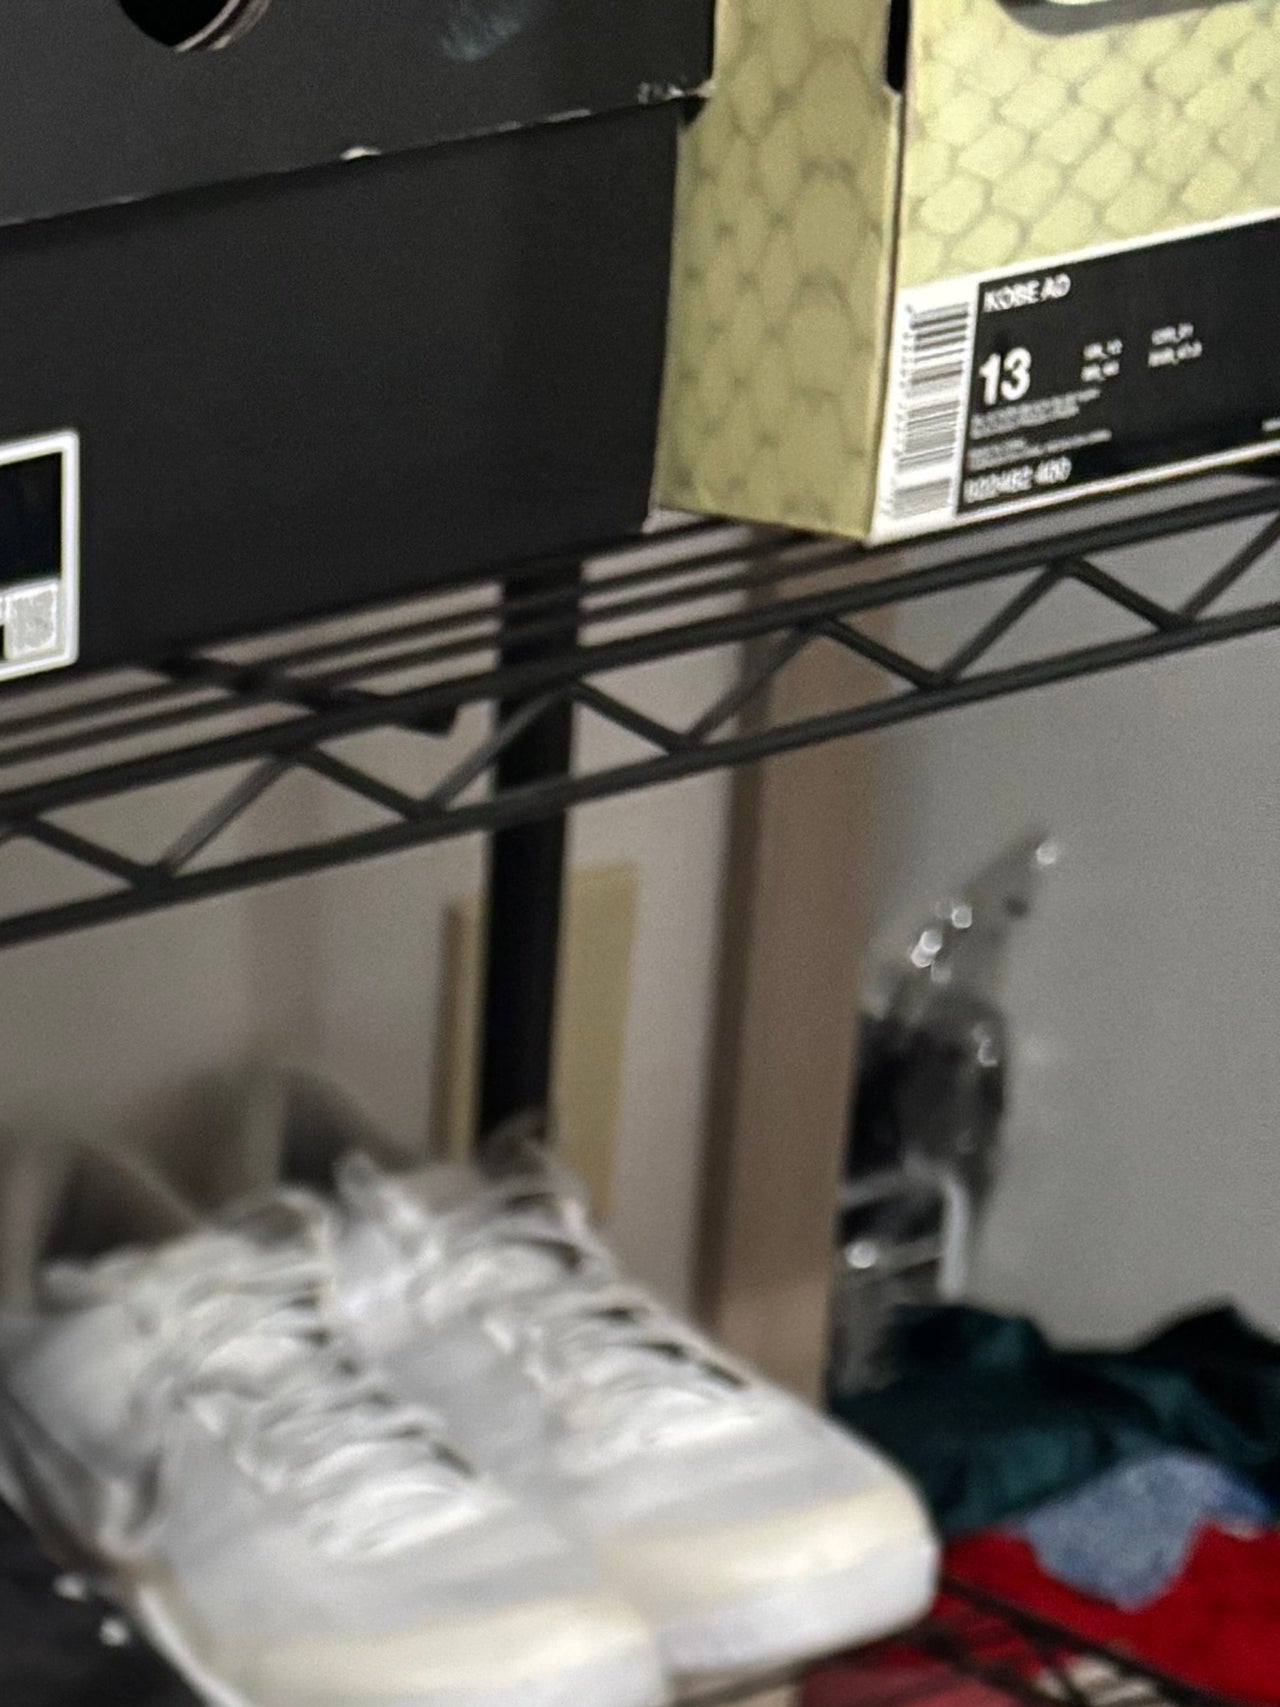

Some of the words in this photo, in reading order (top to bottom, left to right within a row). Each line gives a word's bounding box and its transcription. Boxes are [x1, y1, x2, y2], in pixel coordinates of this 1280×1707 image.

[982, 278, 1040, 313] KOBE
[1040, 272, 1072, 301] AD
[978, 346, 1032, 405] 13
